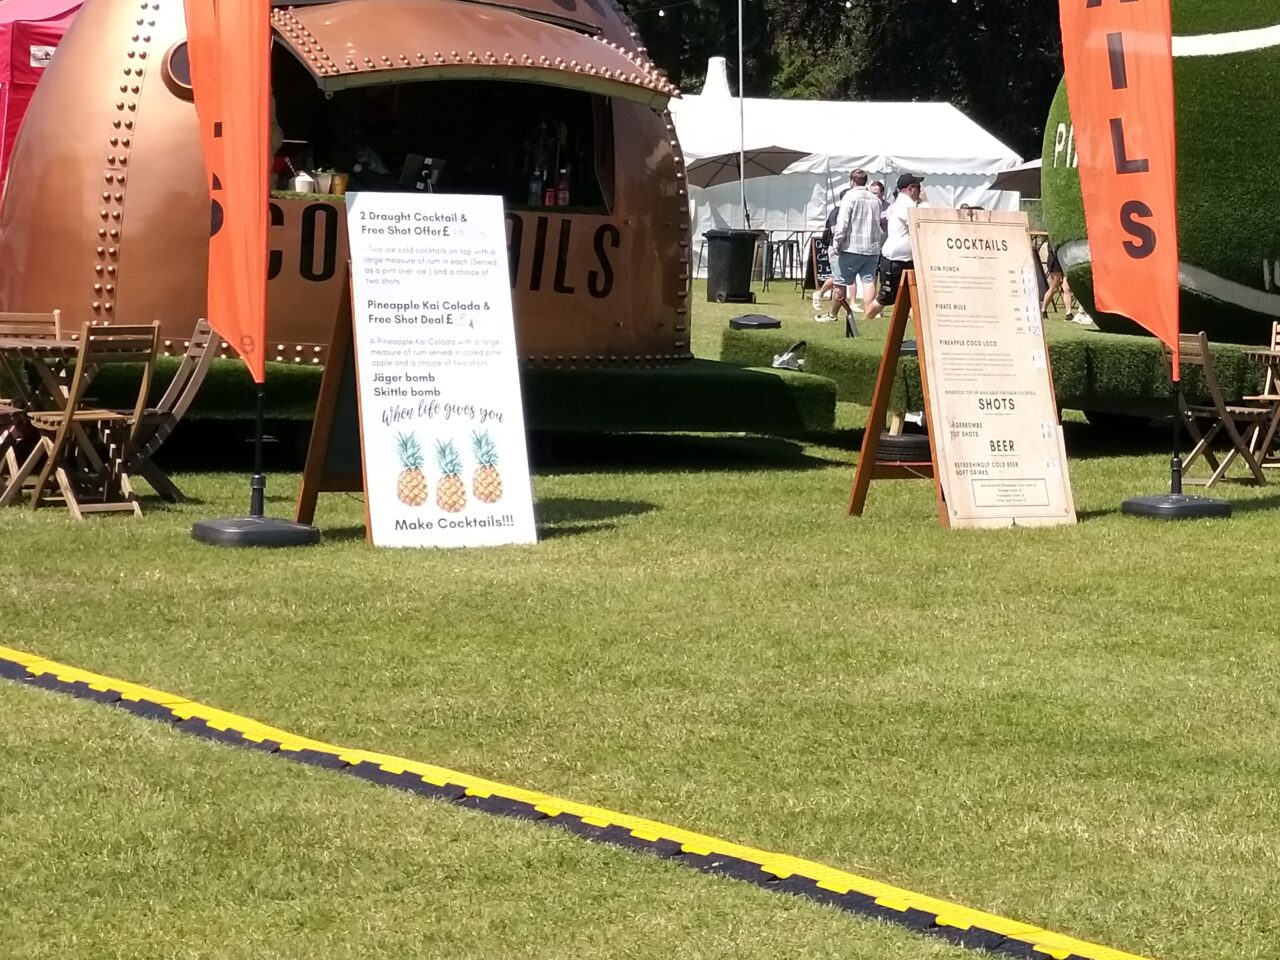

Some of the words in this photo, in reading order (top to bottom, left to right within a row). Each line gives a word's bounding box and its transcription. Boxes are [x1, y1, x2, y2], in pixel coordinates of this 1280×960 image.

[360, 212, 366, 220] 2
[369, 212, 410, 223] Draught
[414, 212, 457, 222] Cocktail
[461, 214, 467, 222] &
[362, 226, 384, 234] Free
[388, 226, 411, 235] Shot
[946, 238, 1008, 252] COCKTAILS
[364, 256, 383, 265] large
[368, 300, 419, 312] Pineapple
[423, 301, 439, 310] Kai
[443, 301, 480, 310] Colada
[484, 302, 490, 310] &
[369, 315, 391, 324] Free
[394, 315, 417, 324] Shot
[373, 373, 402, 384] Jäger
[406, 373, 435, 382] bomb
[374, 387, 407, 396] Skittle
[411, 387, 440, 396] bomb
[979, 398, 1015, 410] SHOTS
[382, 405, 414, 426] When
[418, 399, 441, 418] life
[444, 401, 476, 420] gives
[480, 407, 504, 423] you
[990, 440, 1015, 452] BEER
[395, 518, 433, 530] Make
[438, 515, 514, 528] Cocktails!!!
